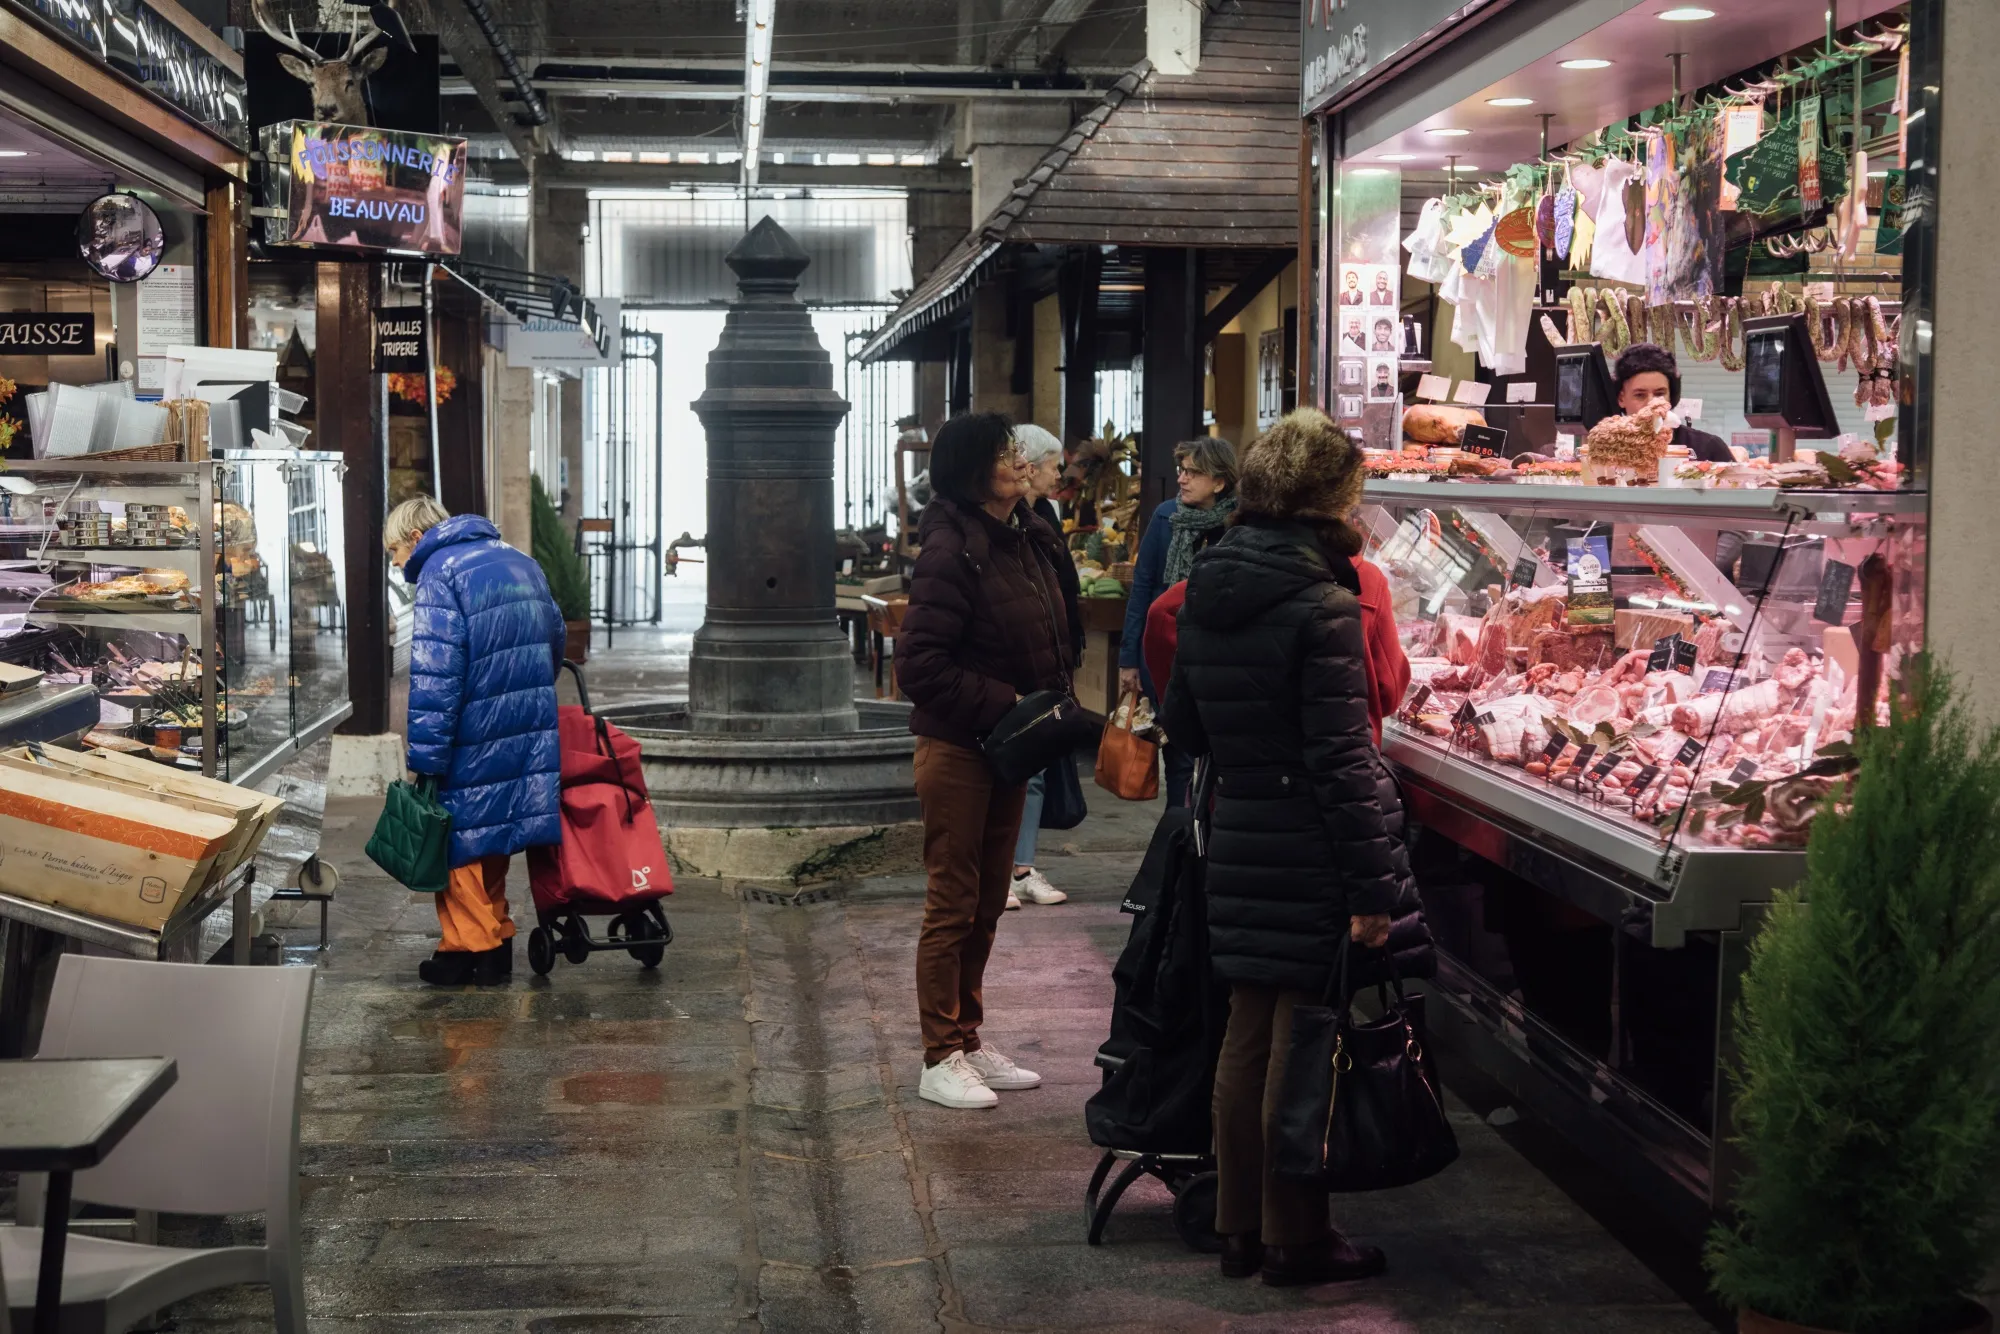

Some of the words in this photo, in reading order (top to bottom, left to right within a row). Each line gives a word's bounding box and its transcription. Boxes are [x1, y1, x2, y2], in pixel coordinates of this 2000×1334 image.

[1764, 140, 1781, 150] SAINT
[1781, 144, 1798, 154] CONS
[298, 139, 460, 185] POISSONNERIE
[328, 196, 425, 224] BEAUVAU
[377, 320, 422, 336] VOLAILLES
[381, 341, 419, 357] TRIPERIE
[41, 850, 68, 866] Perron
[1126, 903, 1146, 911] ROLSER
